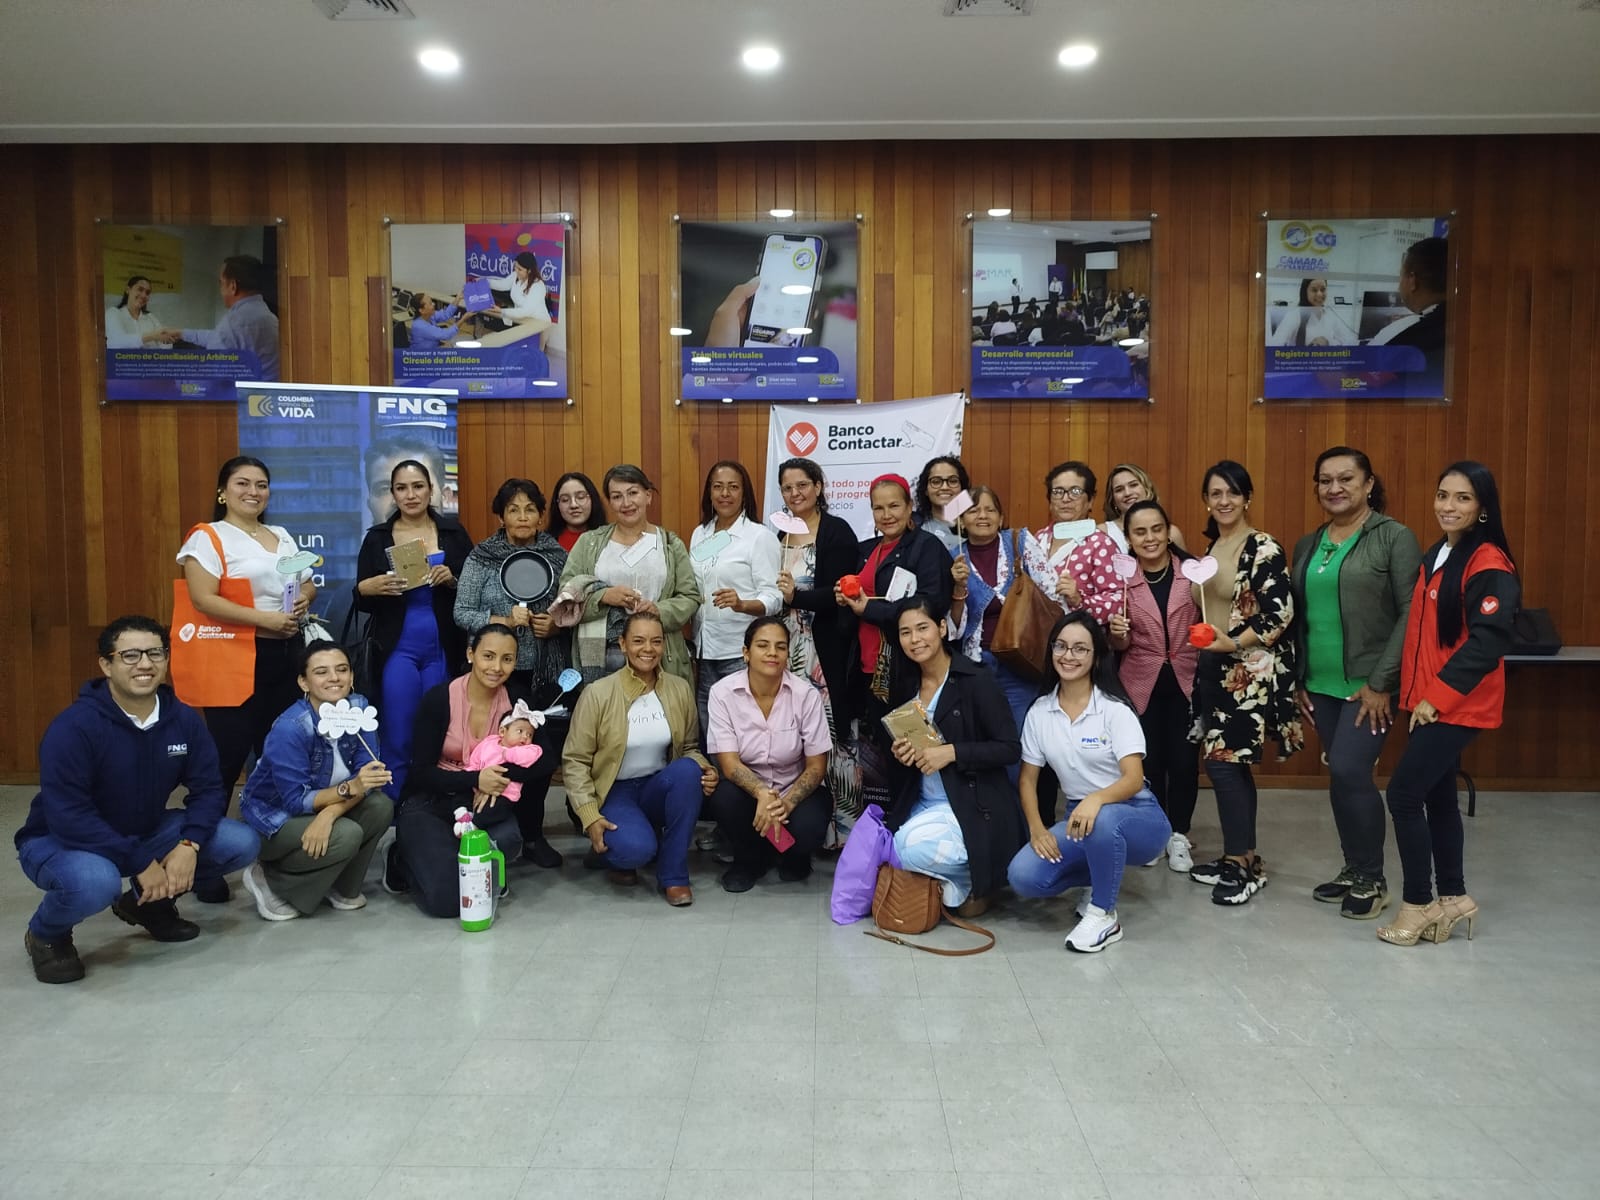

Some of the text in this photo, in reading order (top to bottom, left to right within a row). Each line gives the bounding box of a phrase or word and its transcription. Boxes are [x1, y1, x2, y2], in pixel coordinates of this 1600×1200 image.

[153, 353, 200, 361] Conciliación
[200, 354, 206, 362] y
[206, 353, 239, 362] Arbitraje
[728, 351, 763, 359] virtuales
[981, 350, 1074, 360] Desarrollo empresarial
[1274, 349, 1351, 359] Registro mercantil
[445, 356, 481, 364] Afiliados
[378, 397, 448, 415] FNG
[278, 406, 316, 418] VIDA
[828, 424, 875, 437] Banco
[828, 437, 903, 451] Contactar
[832, 479, 855, 488] todo
[299, 533, 324, 548] un
[167, 743, 188, 752] FNG
